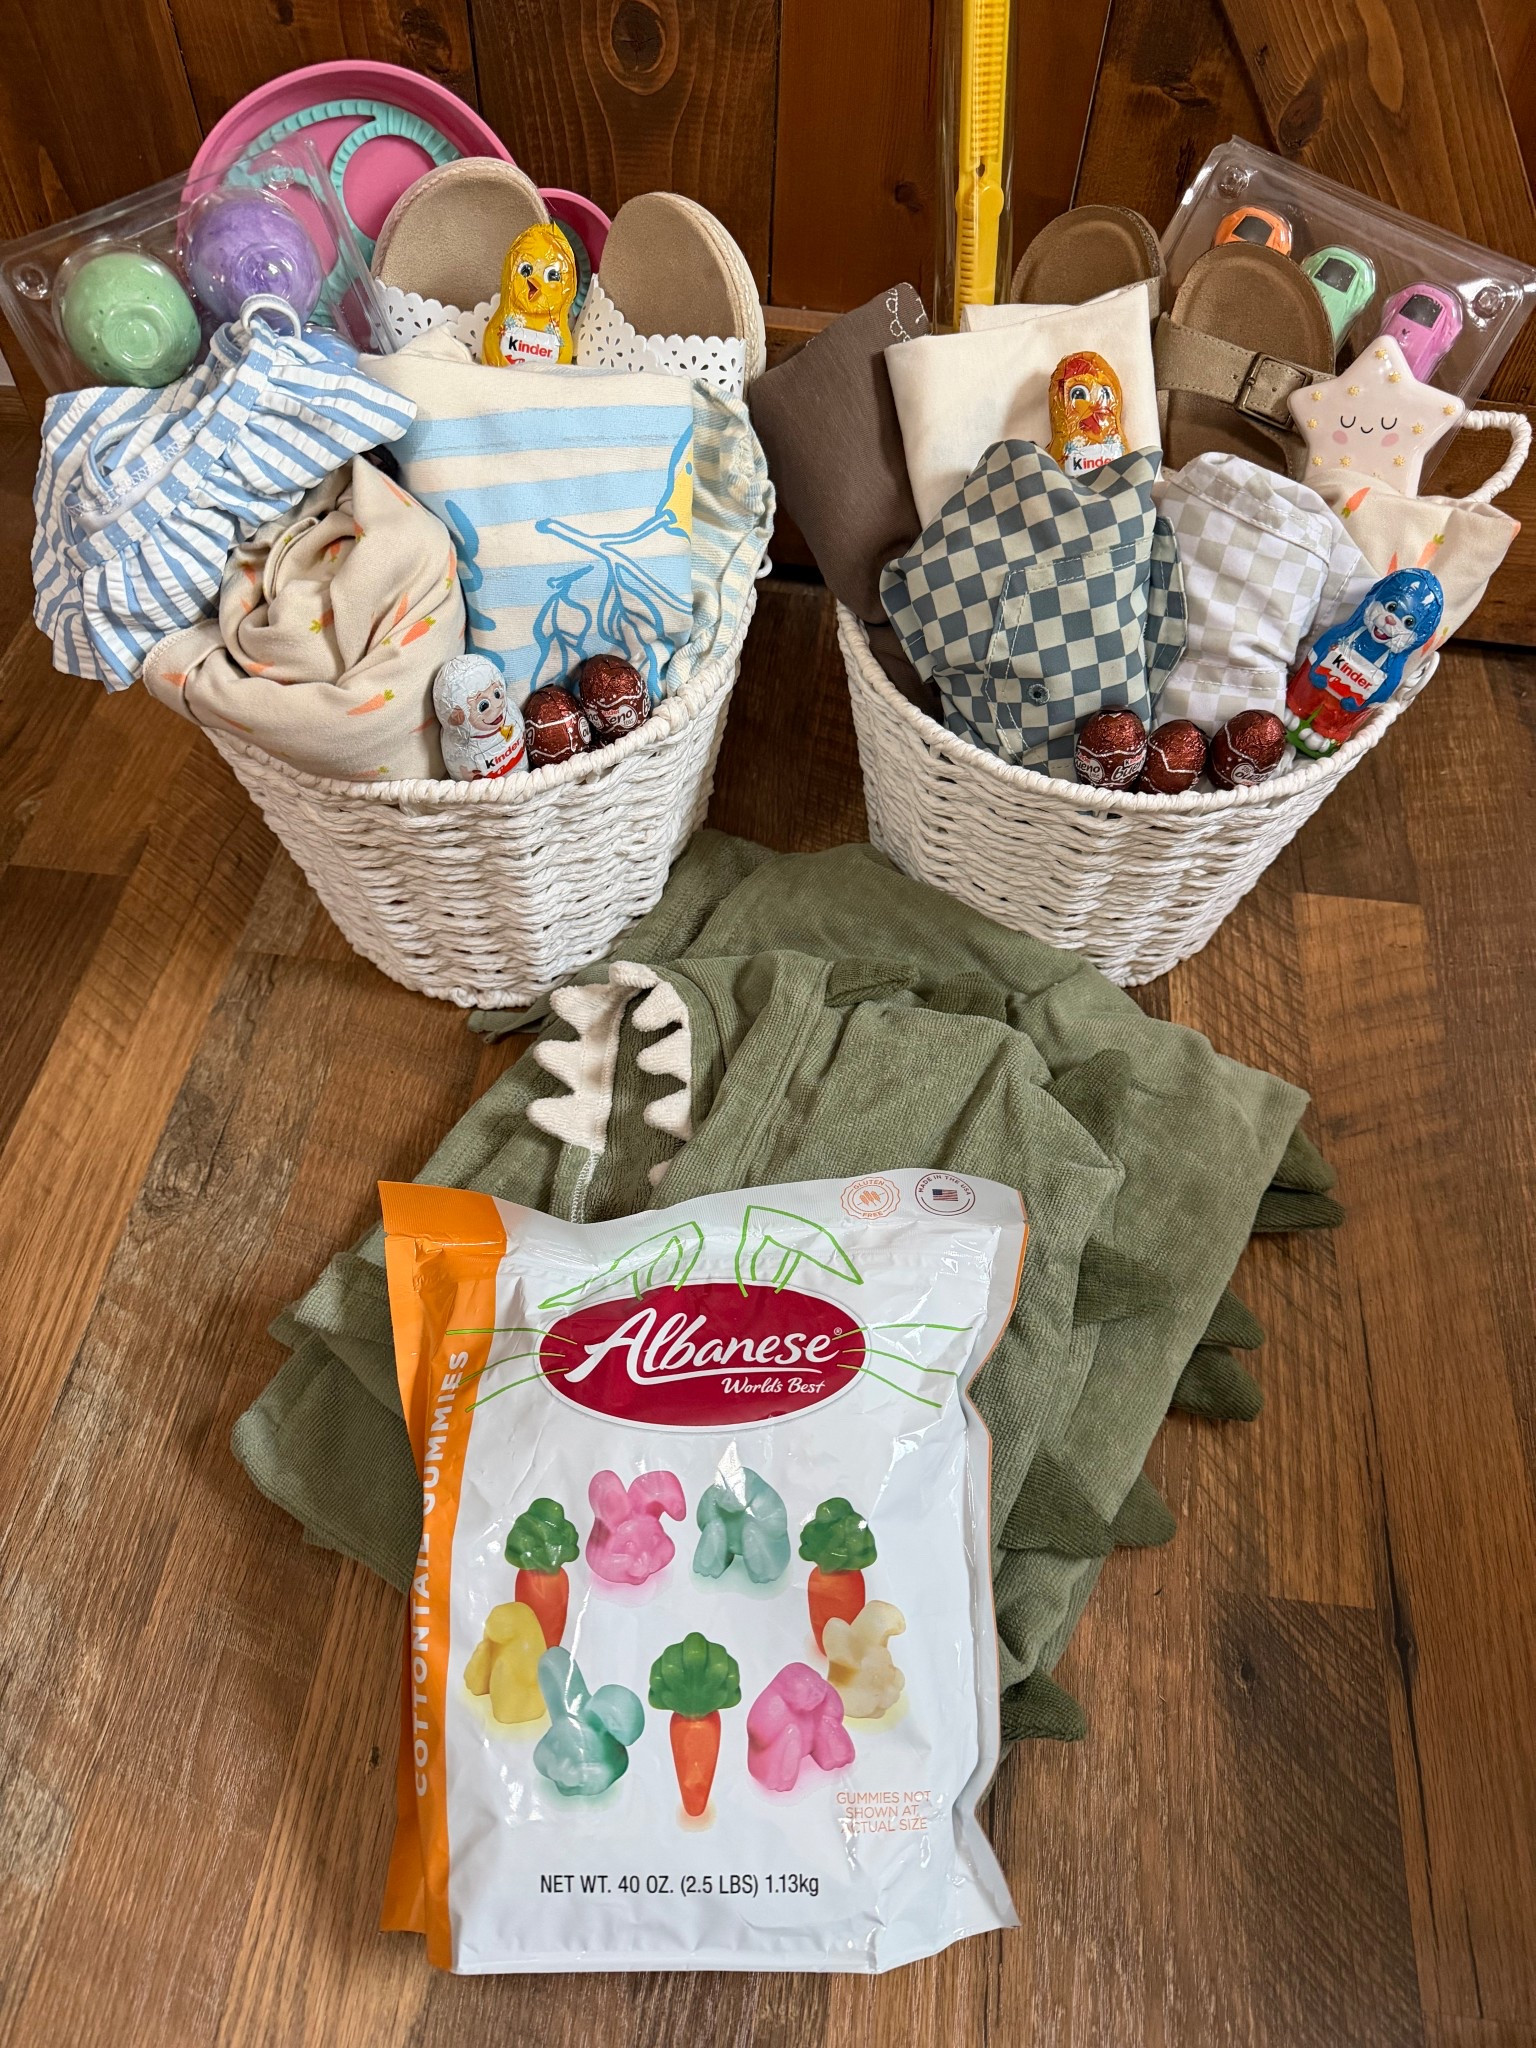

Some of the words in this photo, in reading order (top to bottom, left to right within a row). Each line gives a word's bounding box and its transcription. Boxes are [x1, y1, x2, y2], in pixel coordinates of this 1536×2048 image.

[853, 1179, 885, 1190] GLUTEN
[918, 1177, 933, 1193] MADE
[944, 1175, 960, 1185] THE
[960, 1182, 972, 1196] USA
[862, 1211, 884, 1219] FREE
[563, 1307, 840, 1386] Albanese
[721, 1376, 784, 1394] World's
[787, 1376, 826, 1394] Best
[412, 1533, 431, 1797] COTTONTAIL
[423, 1351, 469, 1516] GUMMIES
[836, 1791, 900, 1805] GUMMIES
[903, 1790, 932, 1803] NOT
[845, 1805, 898, 1819] SHOWN
[902, 1804, 919, 1817] AT
[899, 1817, 928, 1831] SIZE
[540, 1874, 574, 1893] NET
[580, 1874, 612, 1893] WT.
[618, 1875, 640, 1893] 40
[646, 1874, 674, 1894] OZ.
[680, 1874, 713, 1897] (2.5
[719, 1874, 759, 1898] LBS)
[764, 1873, 819, 1897] 1.13kg
